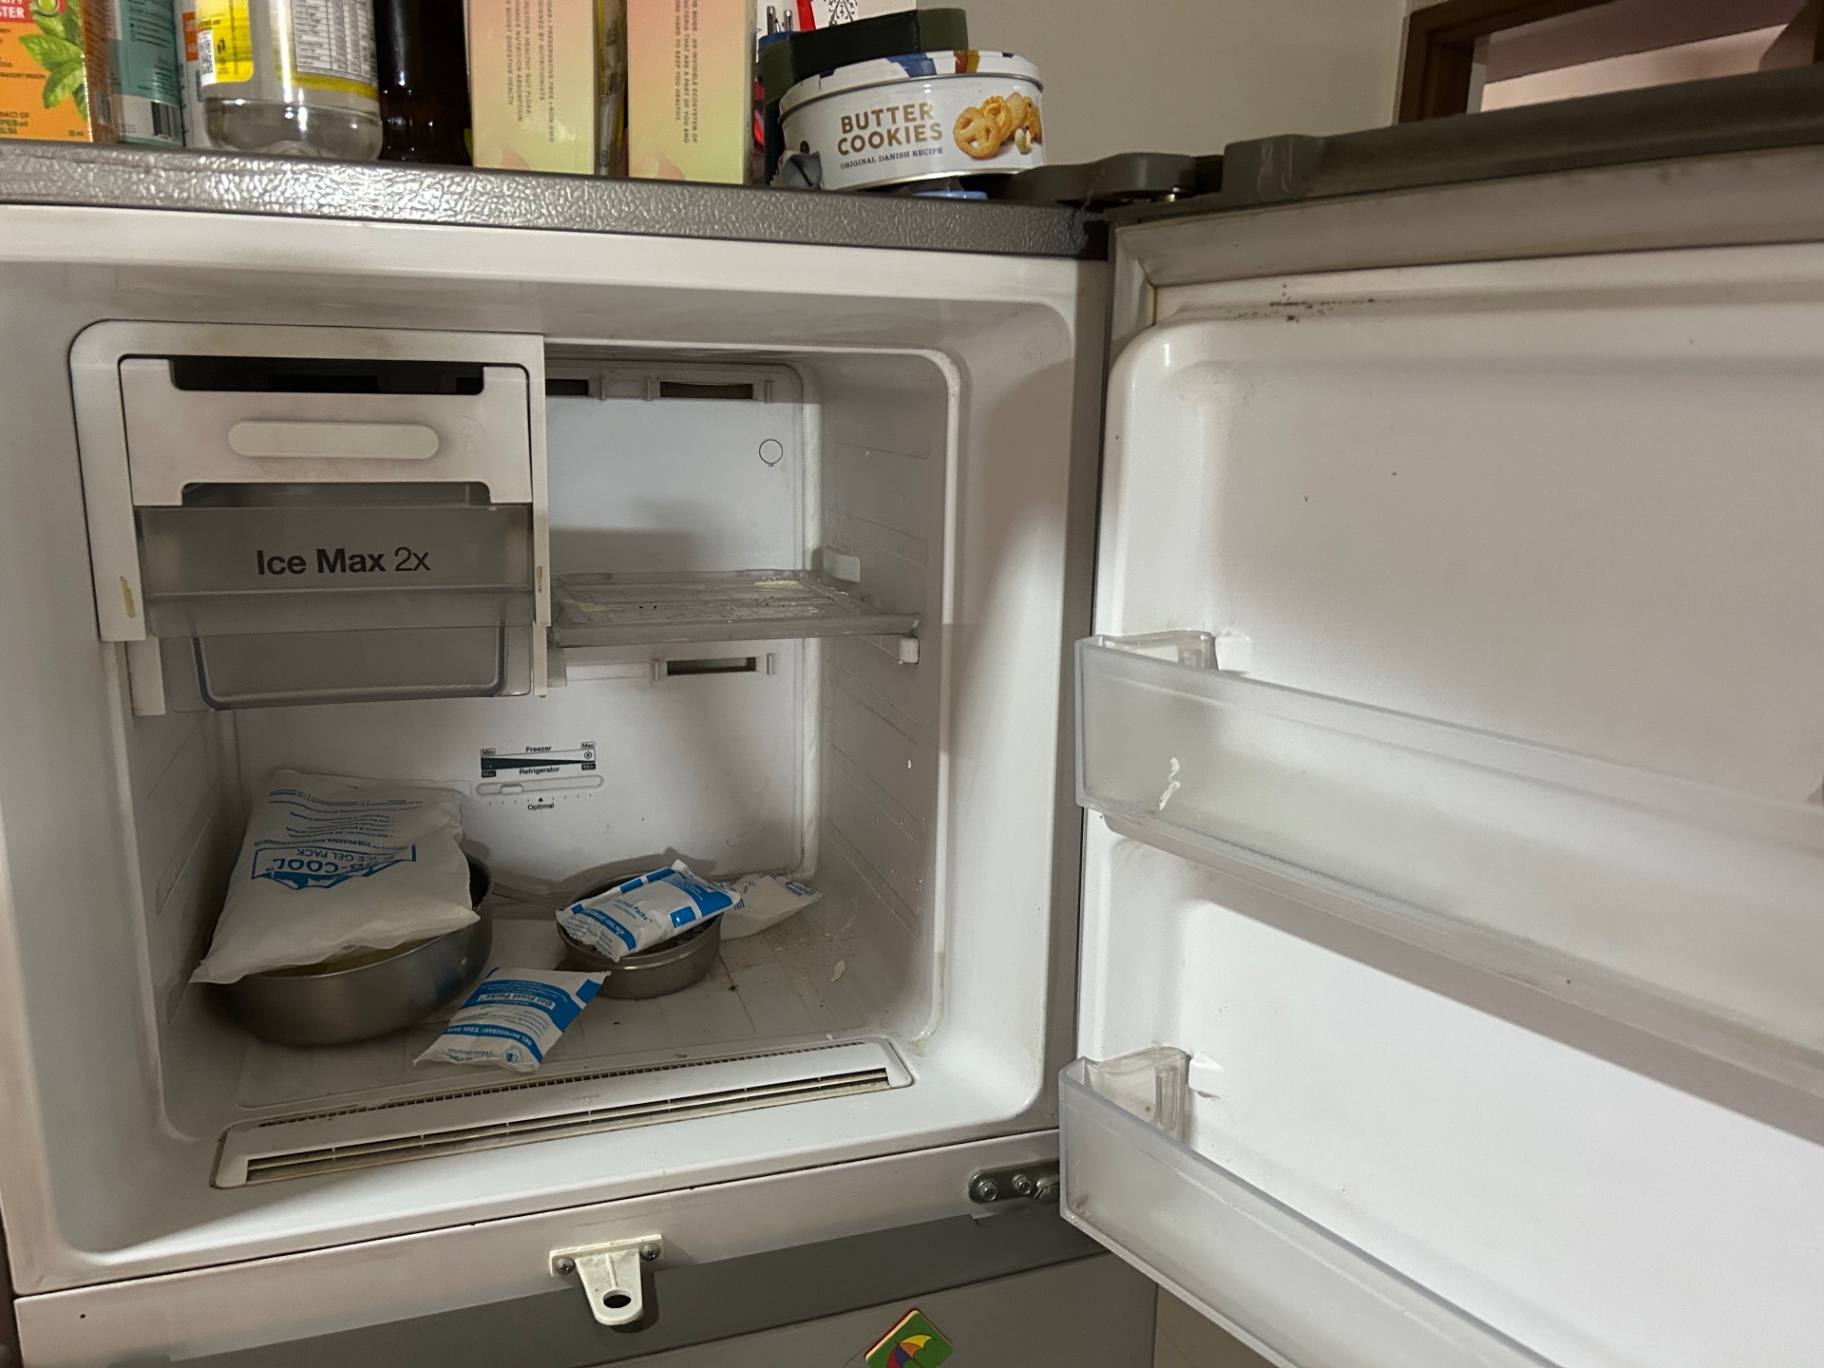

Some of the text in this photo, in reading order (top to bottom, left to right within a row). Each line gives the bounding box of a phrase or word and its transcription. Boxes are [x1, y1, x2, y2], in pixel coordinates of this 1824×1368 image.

[675, 38, 681, 49] TO
[692, 38, 698, 49] AN
[683, 98, 690, 108] OF
[840, 102, 934, 134] BUTTER
[692, 133, 698, 144] OF
[837, 121, 943, 156] COOKIES
[840, 147, 944, 170] ORIGINAL DANISH RECIPE
[256, 546, 432, 576] Ice Max 2x
[525, 745, 552, 753] Freezer
[518, 766, 560, 775] Refrigerator
[527, 803, 555, 812] Optimal
[327, 838, 357, 846] PHARMA
[296, 849, 328, 859] PACK
[331, 852, 355, 862] GEL
[512, 993, 536, 1001] Frost
[537, 998, 553, 1007] Gel
[481, 1028, 521, 1039] REFRIGERANT
[521, 1036, 532, 1046] GEL
